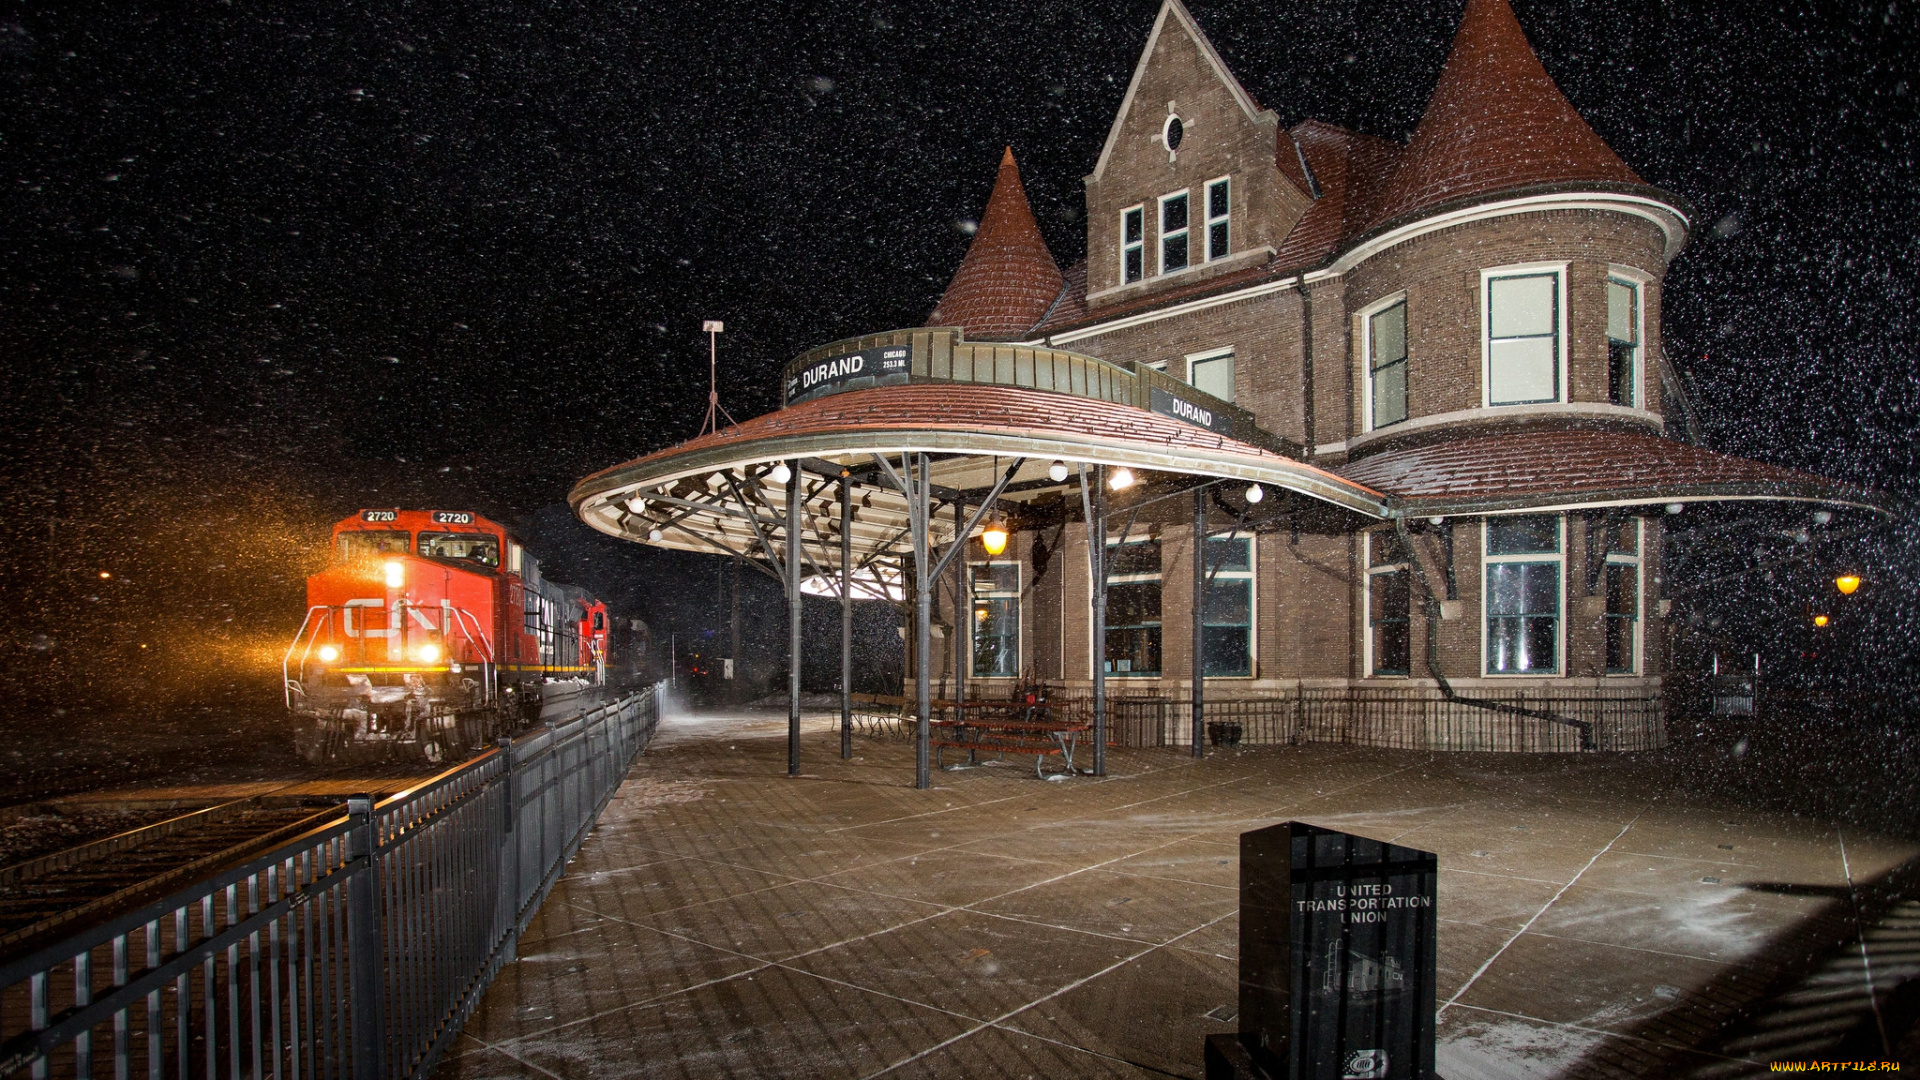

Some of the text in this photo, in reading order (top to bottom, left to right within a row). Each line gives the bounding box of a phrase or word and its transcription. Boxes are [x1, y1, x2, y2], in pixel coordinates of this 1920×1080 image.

[883, 350, 906, 359] CHICAGO
[803, 355, 864, 389] DURAND
[1173, 398, 1212, 426] DURAND
[367, 511, 394, 521] 2720
[439, 513, 469, 524] 2720
[344, 598, 451, 638] CN
[1337, 884, 1392, 897] UNITED
[1297, 896, 1430, 912] TRANSPORTATION
